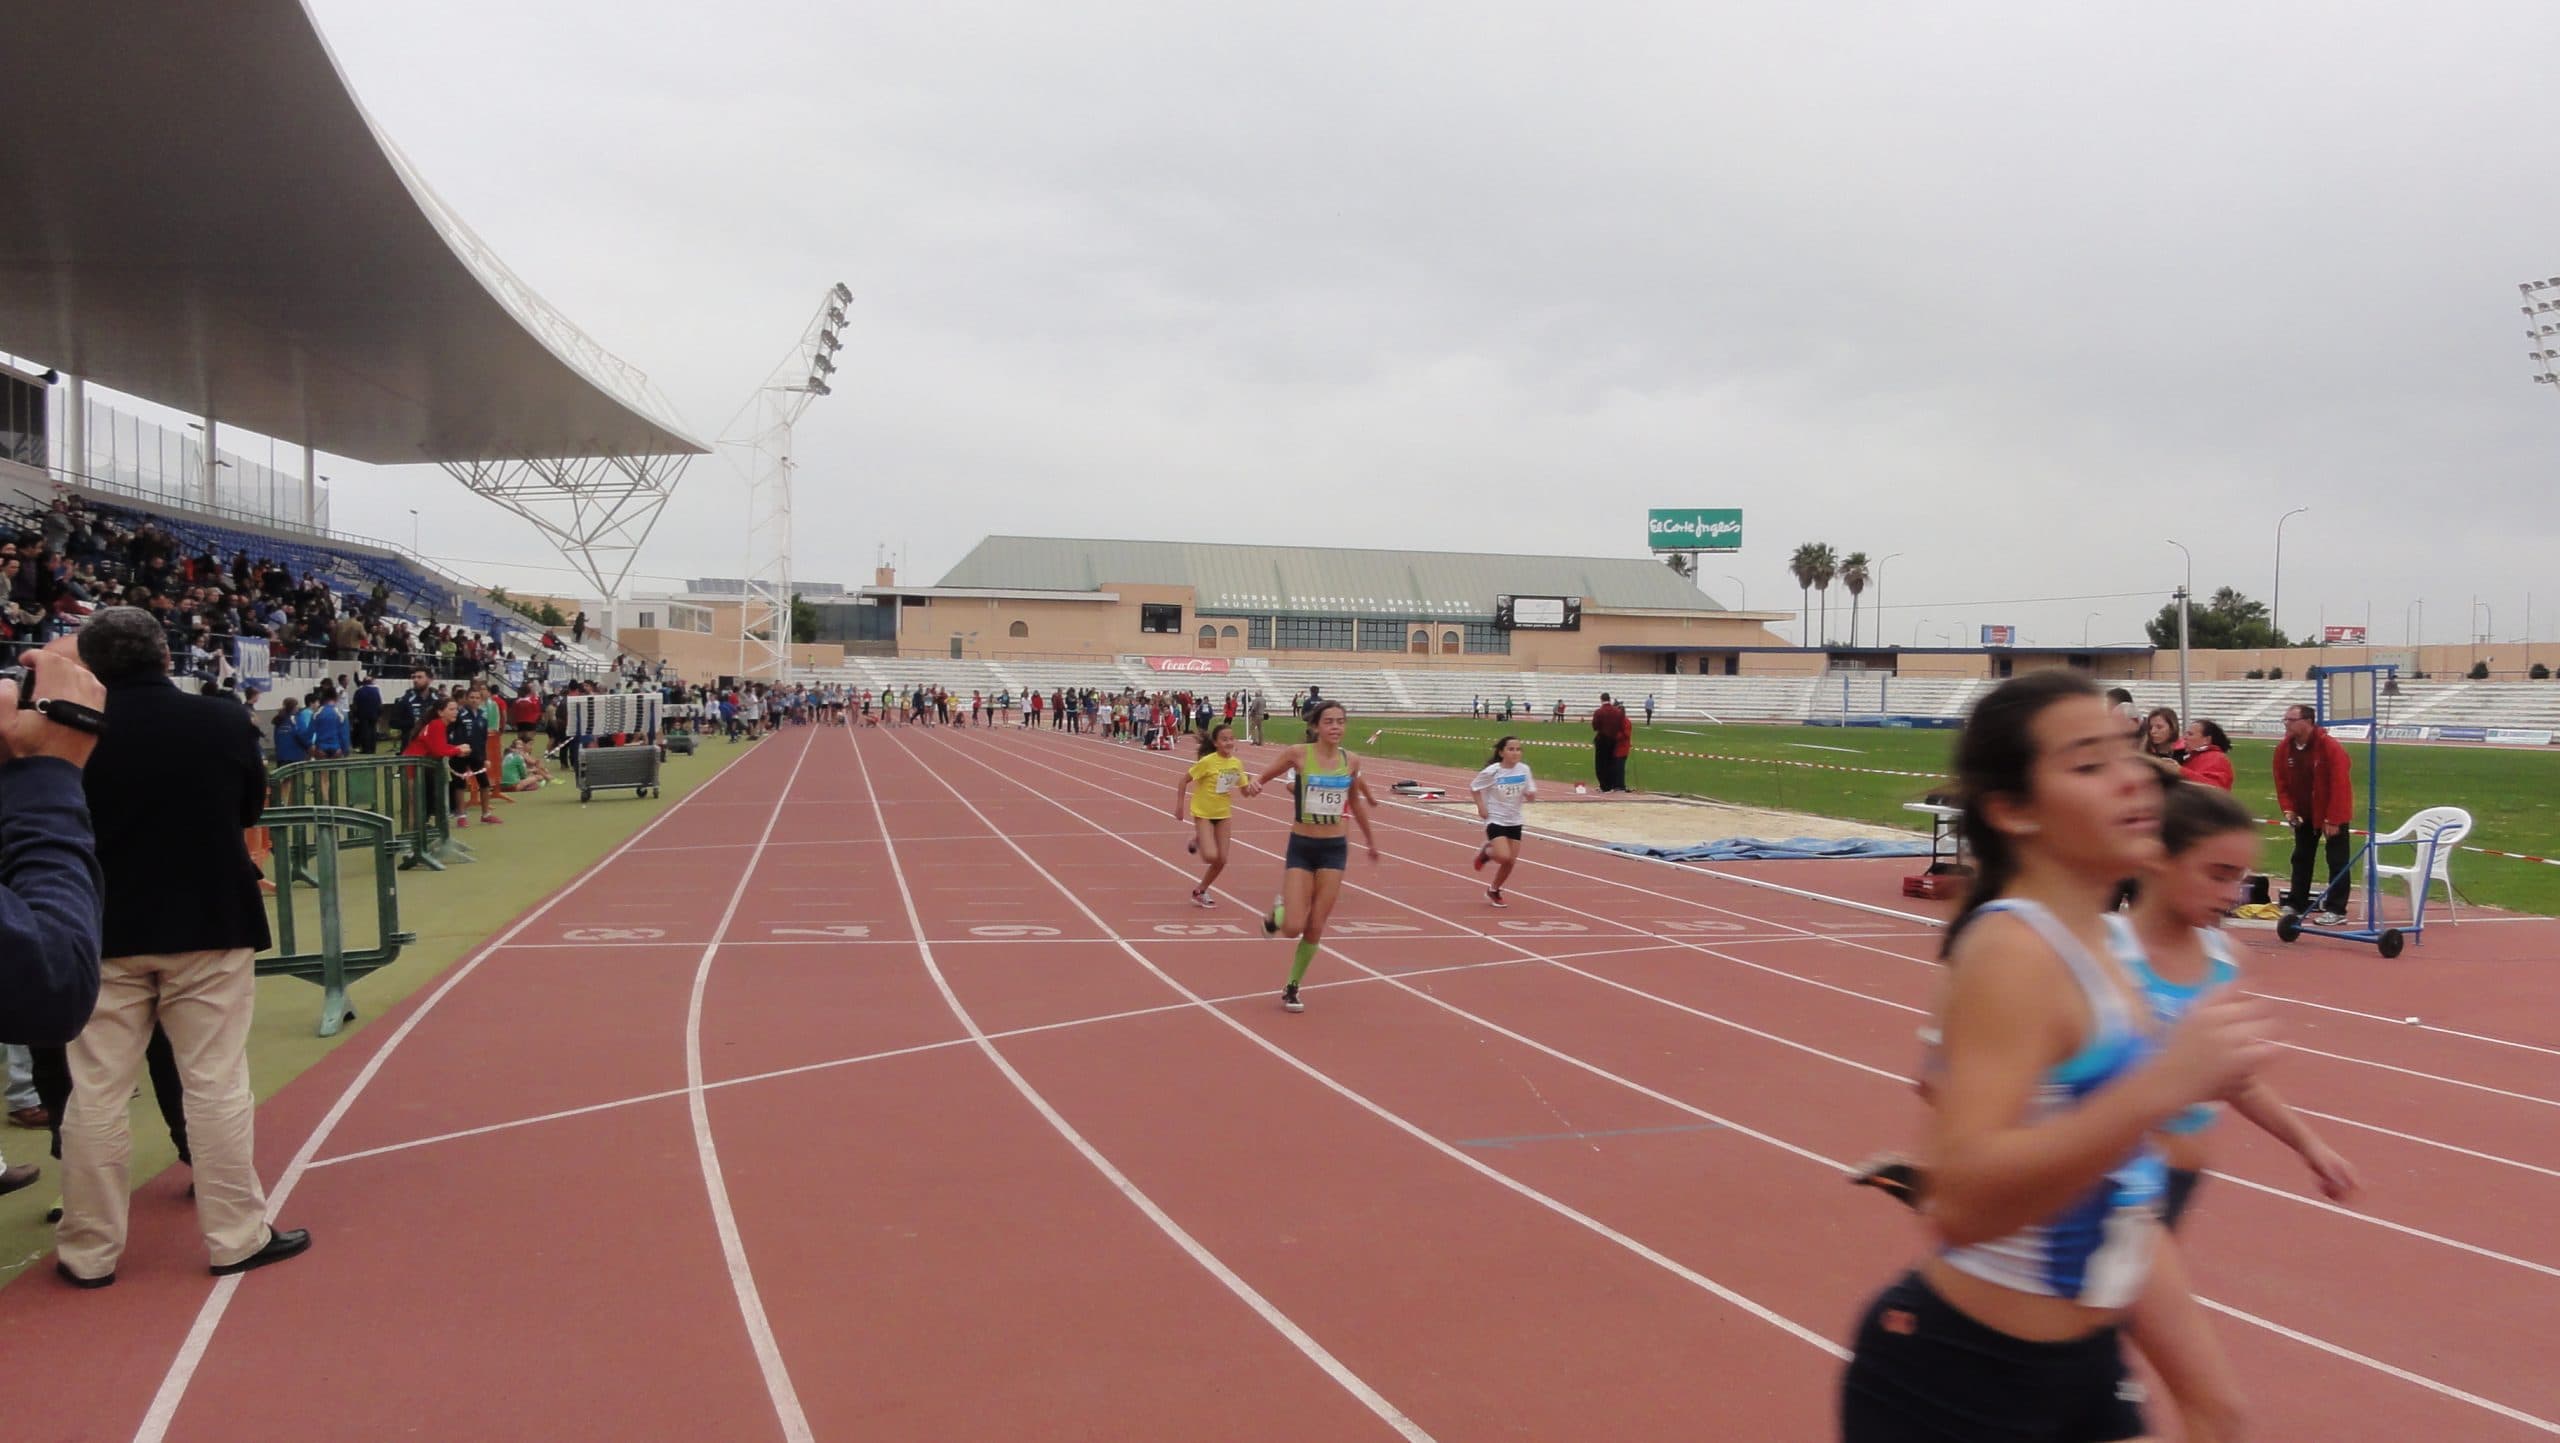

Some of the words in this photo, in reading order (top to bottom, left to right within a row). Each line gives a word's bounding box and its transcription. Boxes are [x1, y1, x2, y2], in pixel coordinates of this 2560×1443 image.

[1650, 520, 1662, 533] El
[1664, 519, 1695, 533] Corte
[1221, 593, 1277, 601] CIUDAD
[1320, 792, 1342, 804] 163
